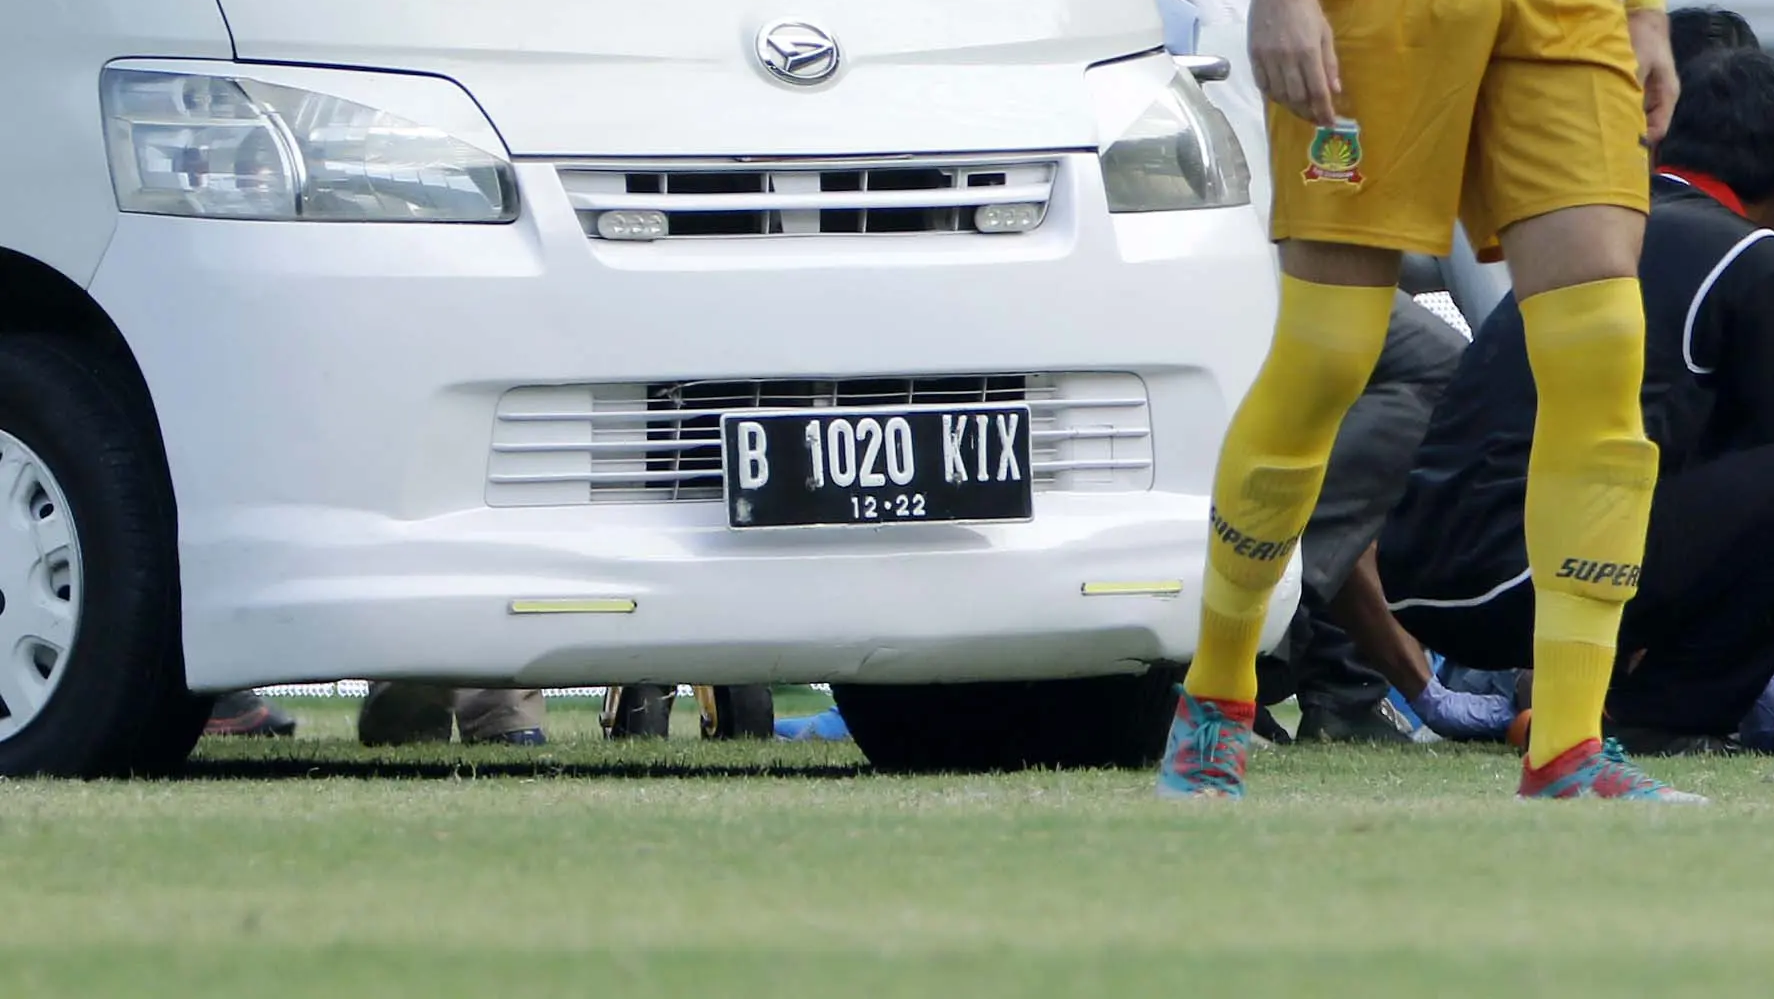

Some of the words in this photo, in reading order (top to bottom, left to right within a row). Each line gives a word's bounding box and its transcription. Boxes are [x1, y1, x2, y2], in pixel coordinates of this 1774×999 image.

[737, 420, 770, 490] B
[805, 415, 916, 488] 1020
[941, 412, 1022, 483] KIX
